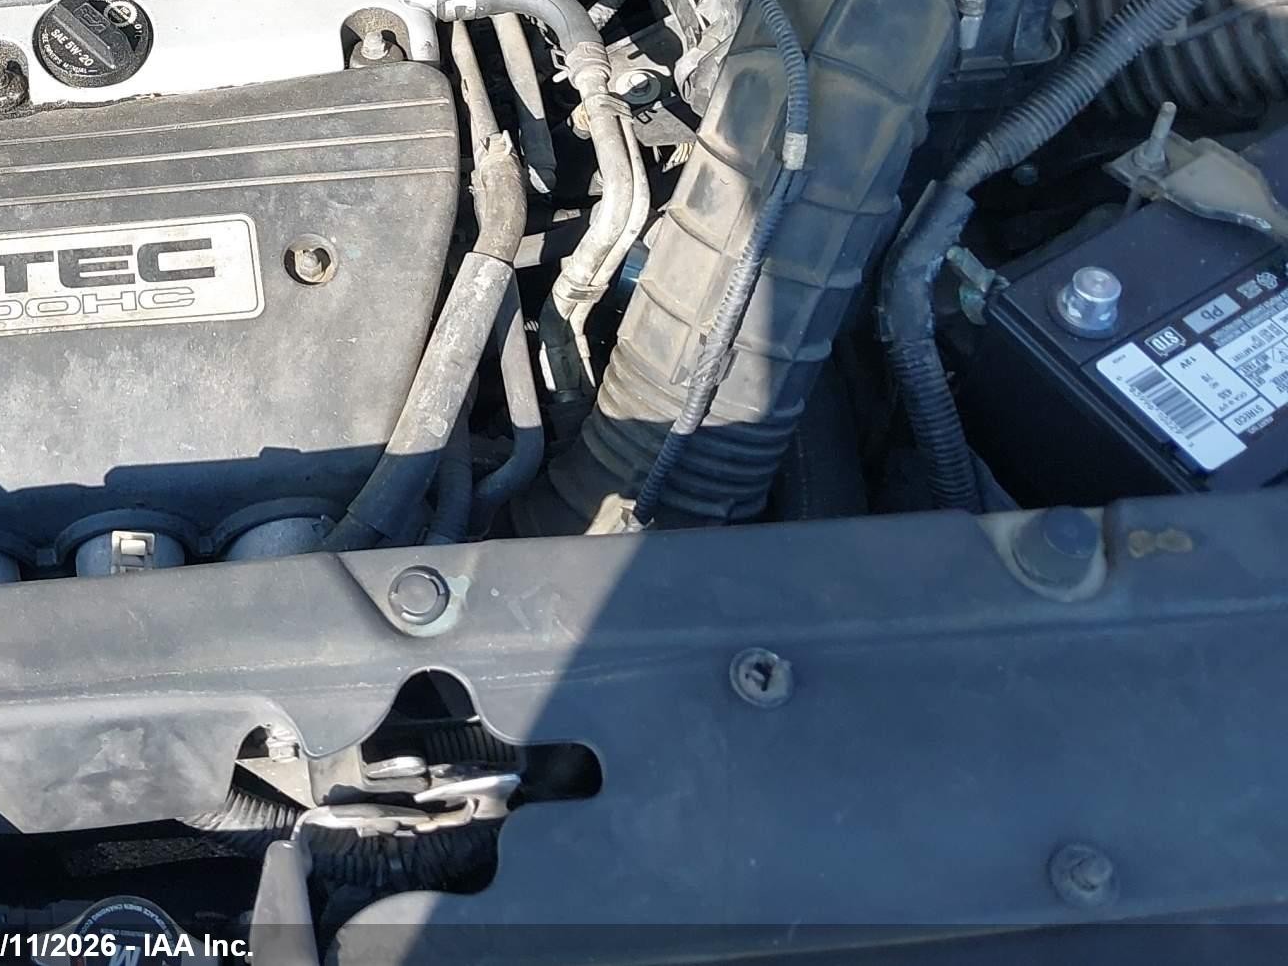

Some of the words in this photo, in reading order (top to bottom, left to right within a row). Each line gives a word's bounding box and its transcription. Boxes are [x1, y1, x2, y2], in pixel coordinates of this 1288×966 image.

[51, 28, 68, 45] SAE
[1200, 305, 1225, 320] Pb
[1149, 331, 1179, 351] STD
[1179, 355, 1197, 370] 12V
